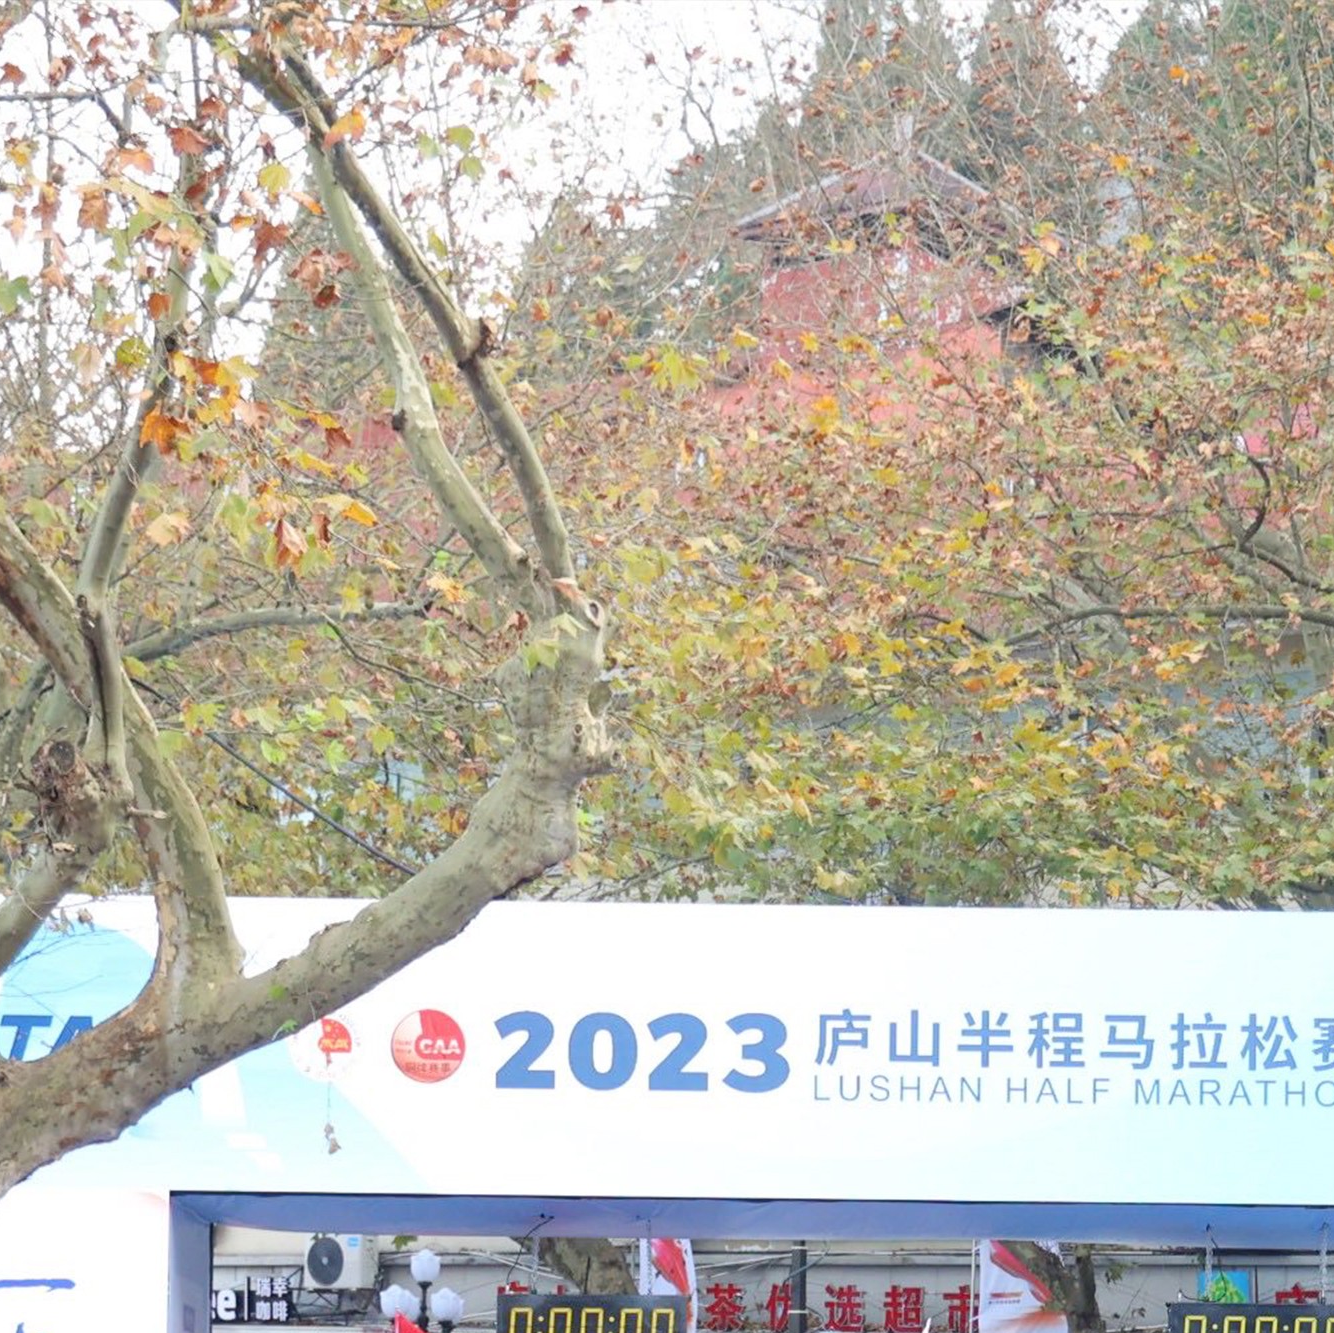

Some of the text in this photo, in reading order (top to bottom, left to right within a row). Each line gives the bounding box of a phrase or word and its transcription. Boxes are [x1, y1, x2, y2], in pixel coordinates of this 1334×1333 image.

[418, 1038, 461, 1055] CAA
[494, 1010, 791, 1093] 2023
[814, 1074, 984, 1102] LUSHAN
[1006, 1077, 1111, 1105] HALF
[255, 1277, 288, 1298] 瑞幸
[255, 1300, 288, 1322] 咖啡
